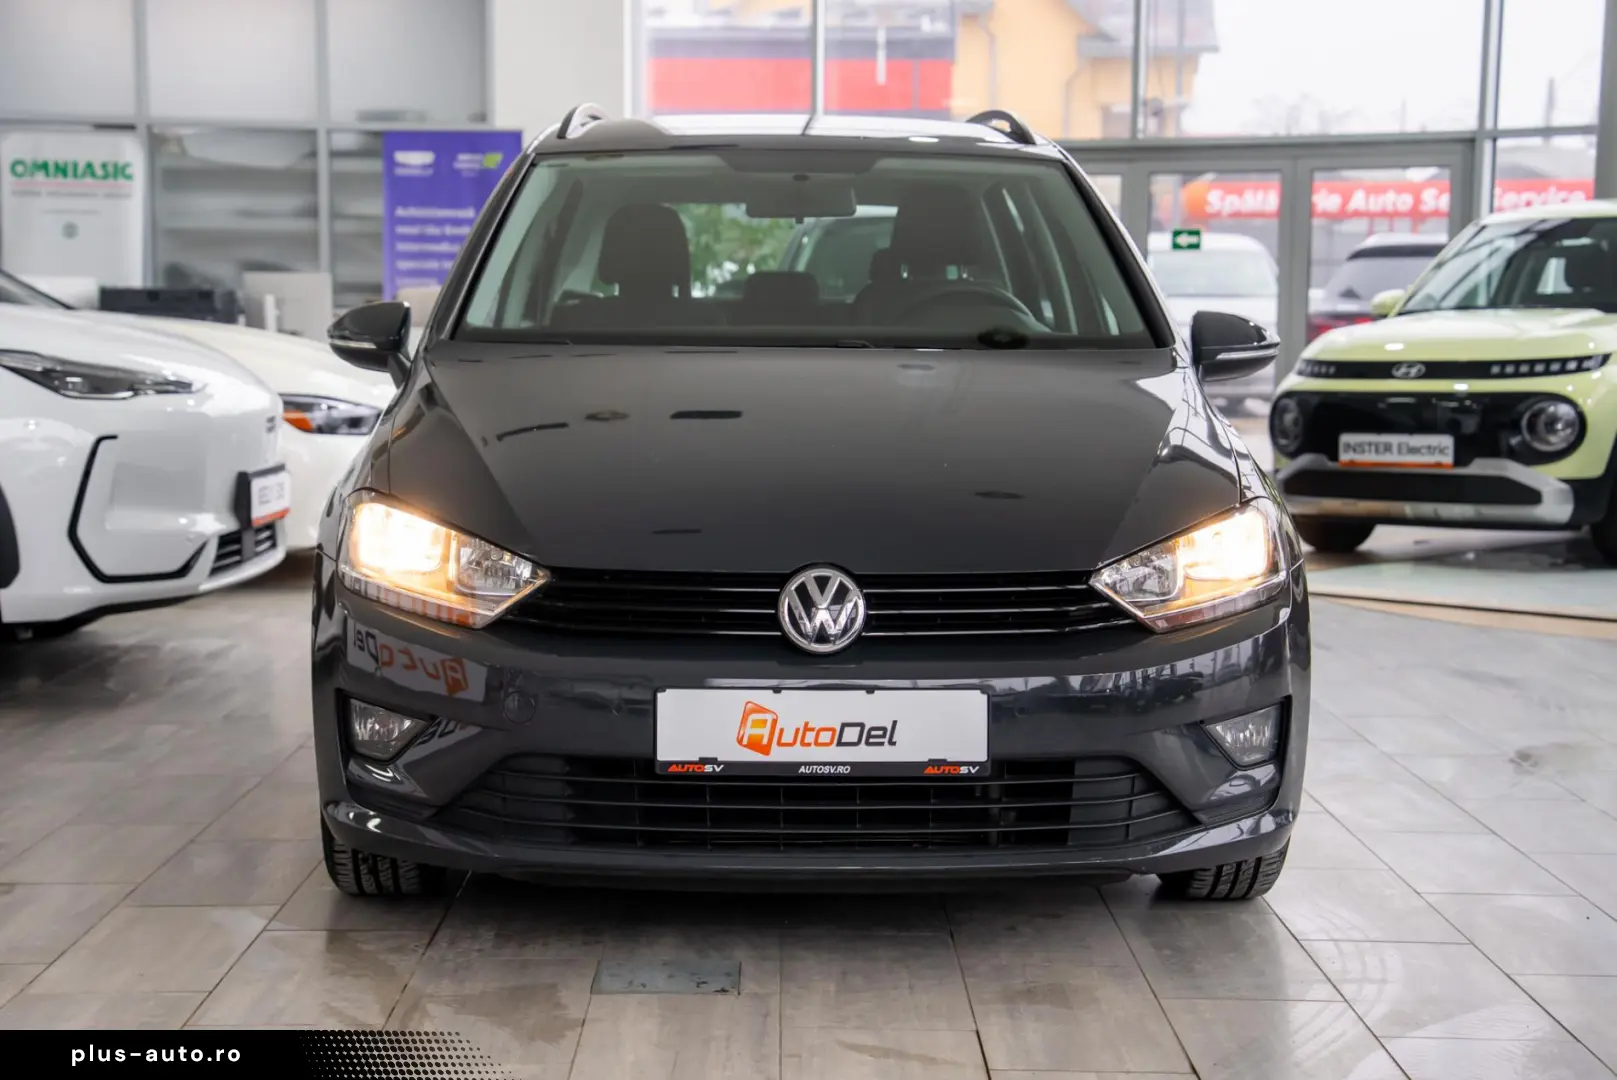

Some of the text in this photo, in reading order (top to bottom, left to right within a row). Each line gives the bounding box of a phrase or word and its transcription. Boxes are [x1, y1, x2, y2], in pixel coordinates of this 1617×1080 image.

[1347, 188, 1414, 214] Auto
[1342, 441, 1451, 456] INSTER Electric
[739, 707, 898, 751] AutoDel
[667, 763, 980, 775] AUTOSV AUTOSV.RO AUTOSV
